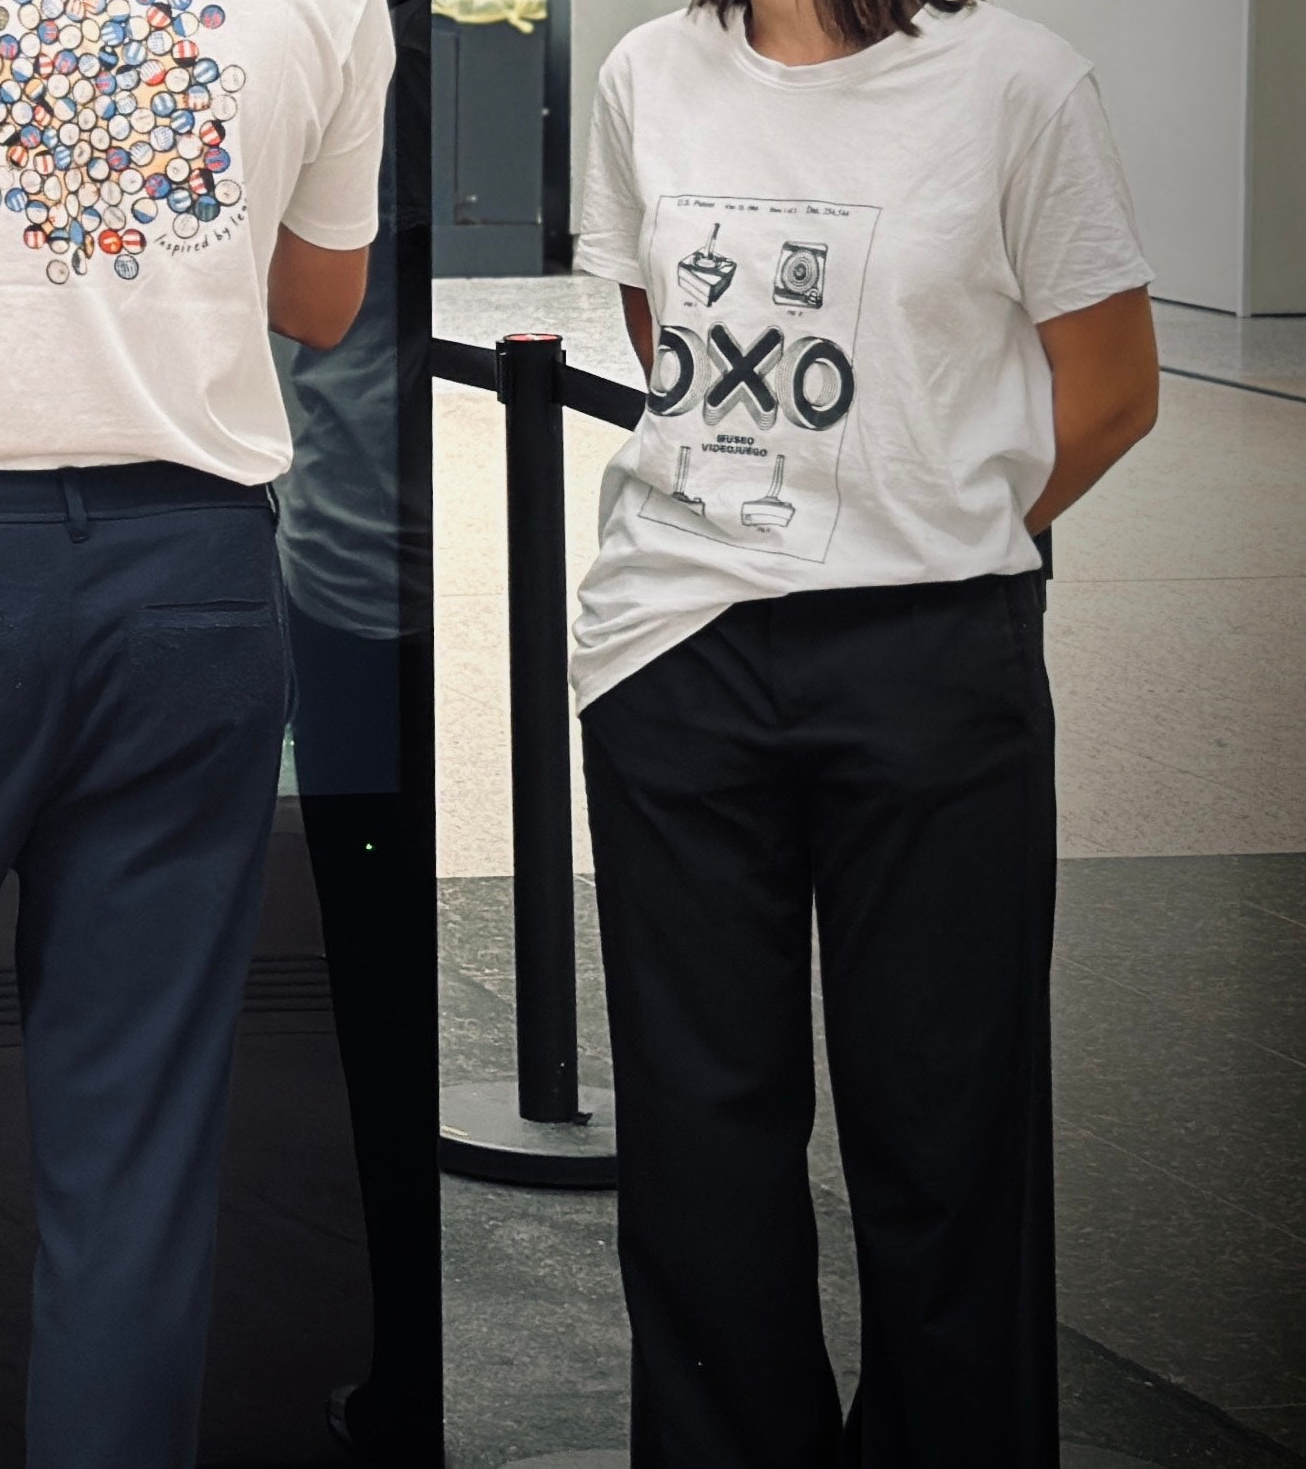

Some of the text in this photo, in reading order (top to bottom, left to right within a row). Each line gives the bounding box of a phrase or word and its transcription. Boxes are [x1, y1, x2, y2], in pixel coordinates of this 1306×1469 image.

[214, 227, 232, 242] by
[647, 321, 854, 431] OXO
[701, 443, 768, 458] VIDEOJUEGO
